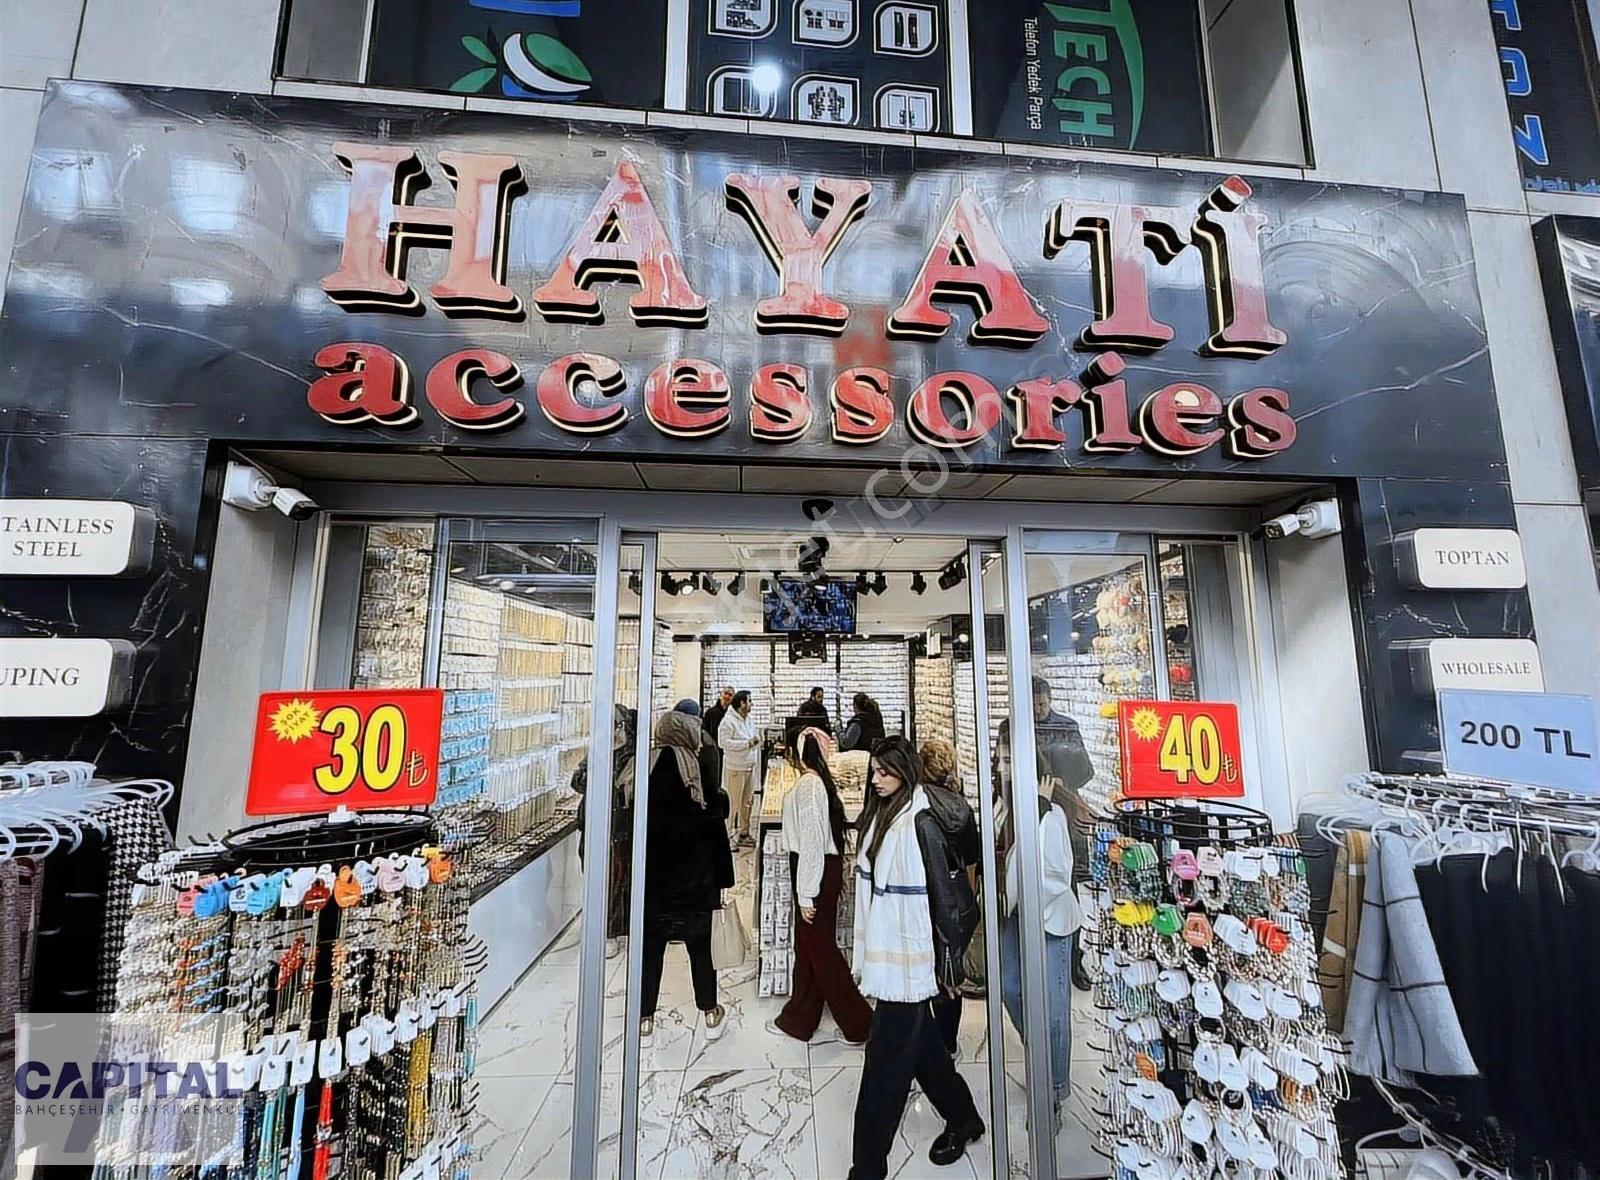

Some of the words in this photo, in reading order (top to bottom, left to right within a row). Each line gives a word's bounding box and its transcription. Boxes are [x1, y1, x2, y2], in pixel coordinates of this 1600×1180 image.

[1024, 17, 1040, 56] Telefon
[1026, 59, 1043, 94] Yedek
[1027, 96, 1043, 131] Parça
[307, 342, 1297, 458] accessories
[12, 541, 82, 557] STEEL
[1435, 550, 1510, 565] TOPTAN
[1441, 662, 1531, 675] WHOLESALE
[1459, 720, 1521, 749] 200
[1534, 727, 1591, 759] TL
